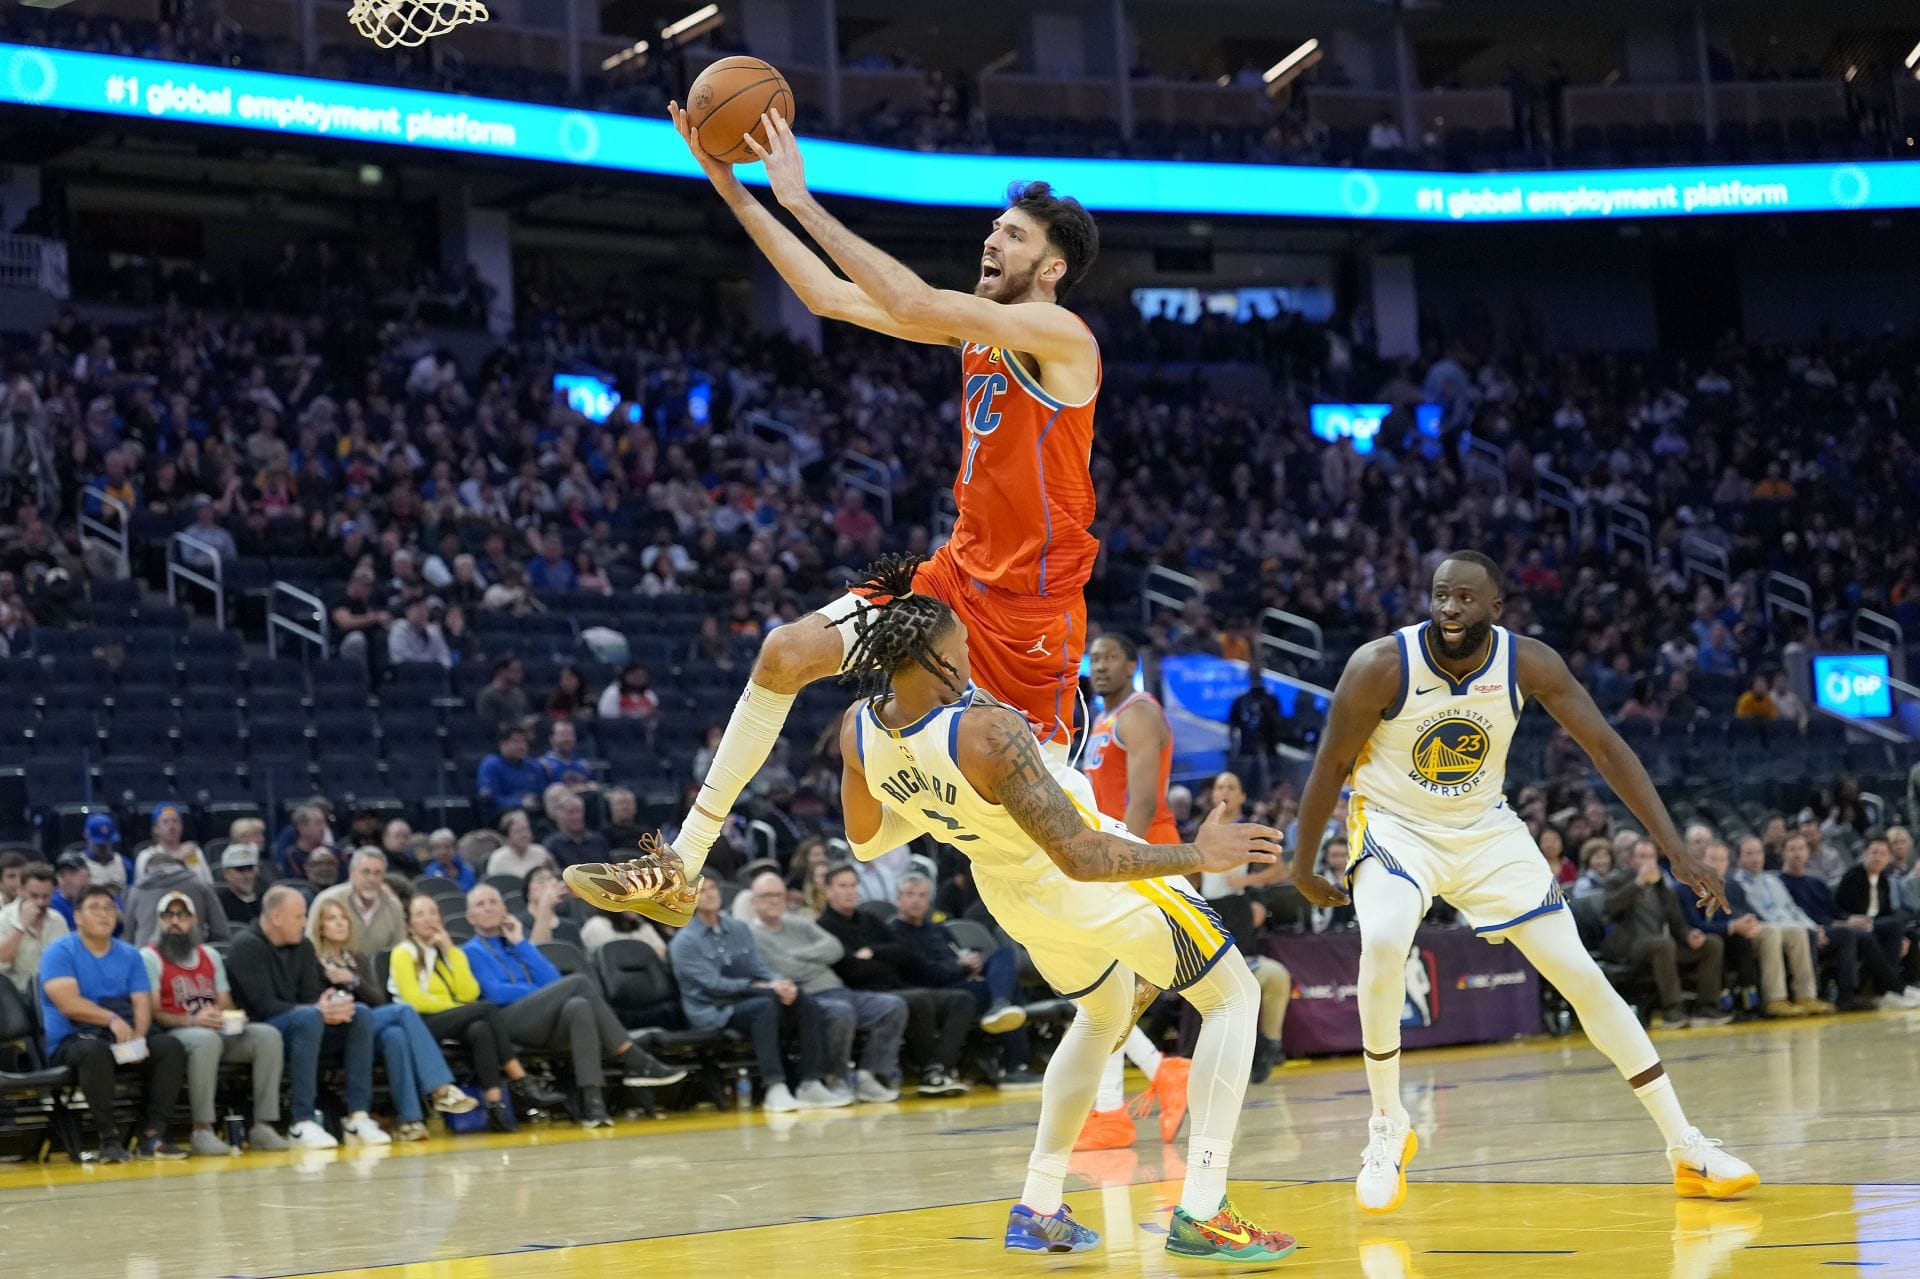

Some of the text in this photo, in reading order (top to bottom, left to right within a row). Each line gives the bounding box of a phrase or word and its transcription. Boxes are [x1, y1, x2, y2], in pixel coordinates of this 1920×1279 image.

[106, 75, 517, 147] #1 global employment platform
[1417, 180, 1788, 218] #1 global employment platform
[1416, 708, 1494, 732] GOLDEN STATE
[1455, 735, 1482, 752] 23
